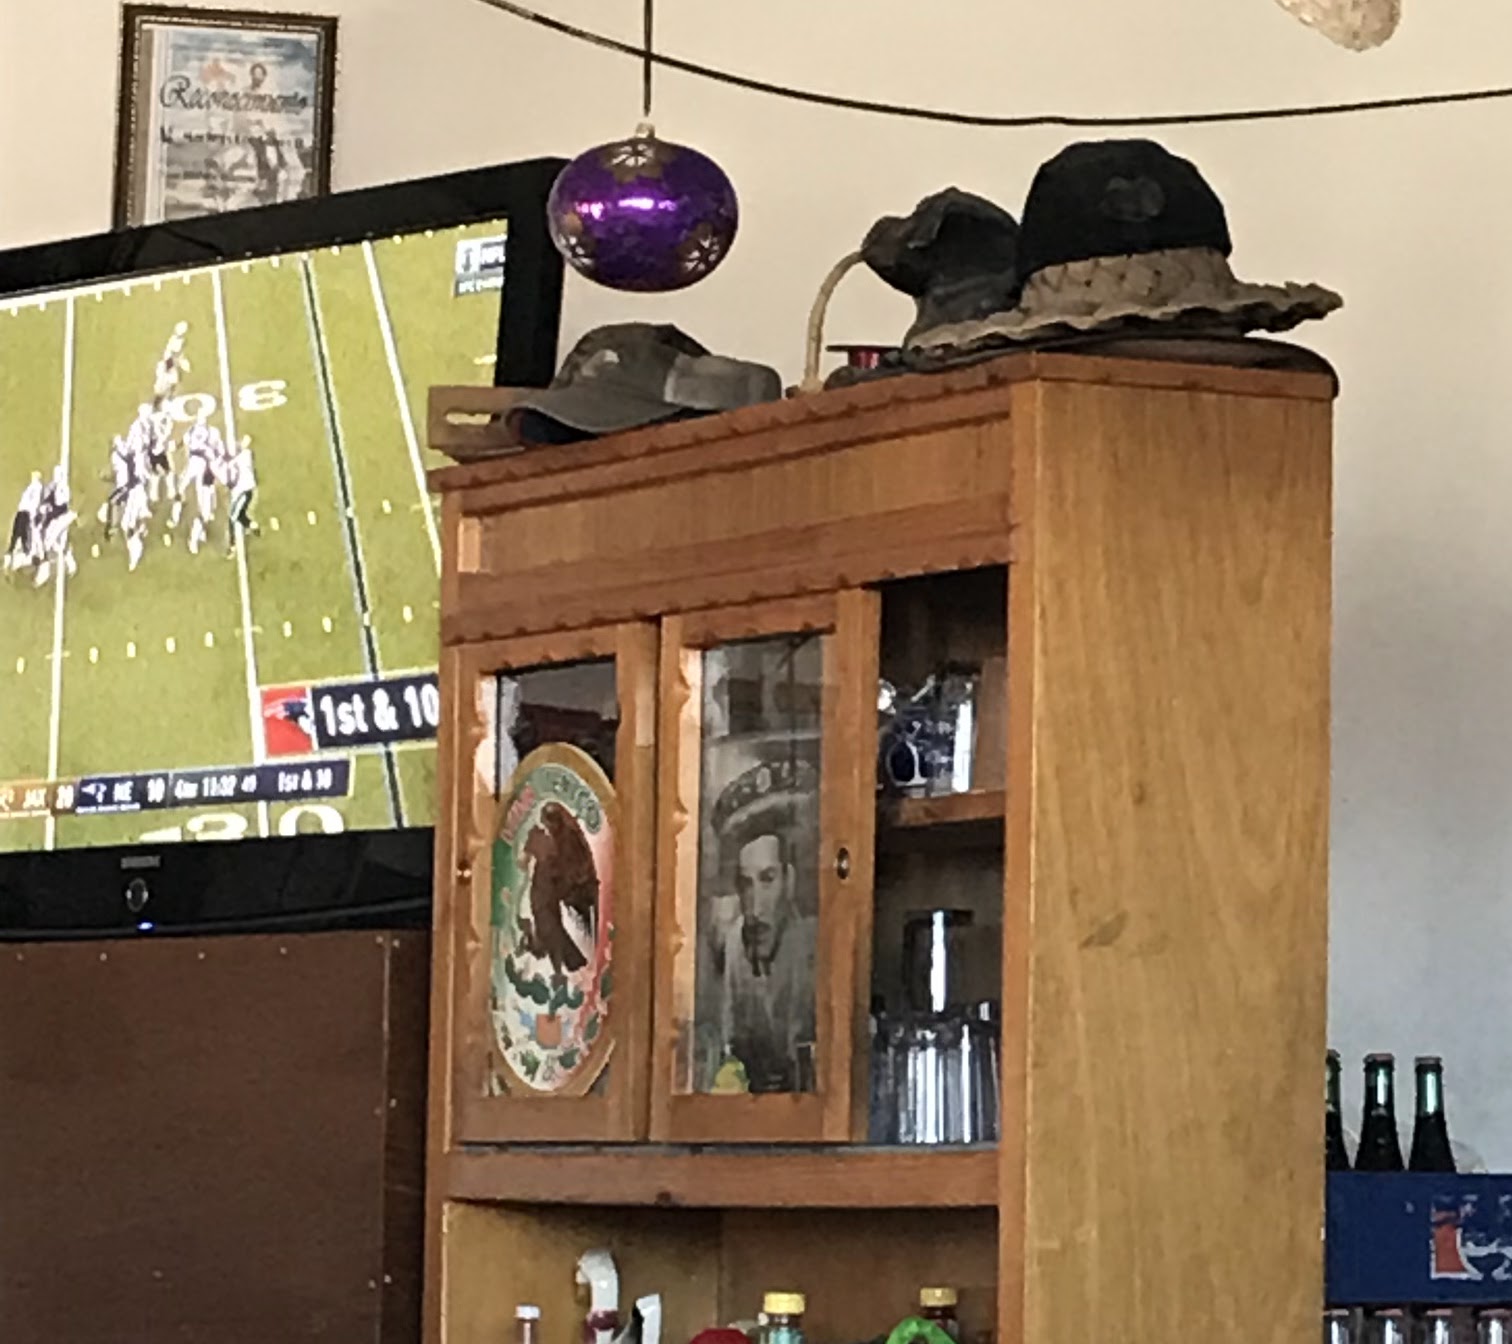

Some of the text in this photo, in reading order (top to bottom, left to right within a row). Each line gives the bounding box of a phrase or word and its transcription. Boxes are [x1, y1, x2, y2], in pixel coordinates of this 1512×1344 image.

[319, 683, 439, 737] 1st & 10
[113, 780, 134, 803] NE
